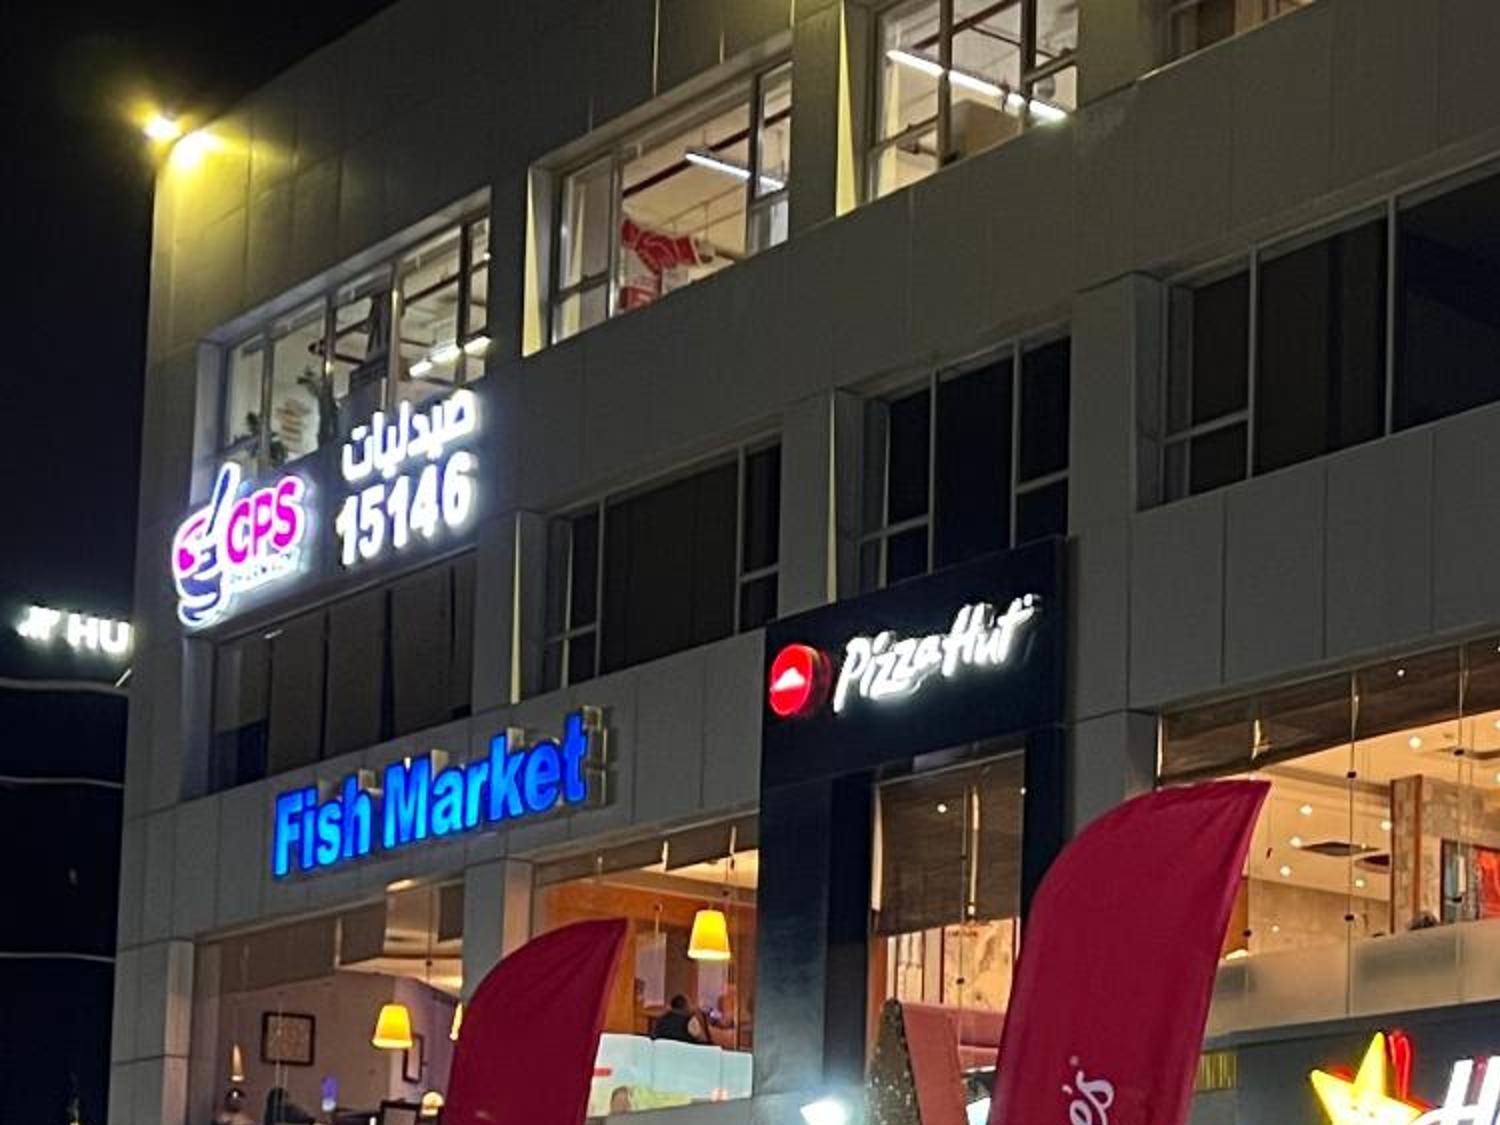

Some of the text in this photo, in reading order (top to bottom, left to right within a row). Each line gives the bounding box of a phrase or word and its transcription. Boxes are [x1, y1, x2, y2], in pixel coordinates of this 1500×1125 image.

[341, 387, 477, 481] صيدليات
[226, 475, 304, 565] CPS
[335, 450, 473, 566] 15146
[834, 594, 1037, 713] Pizza Hut
[273, 709, 590, 879] Fish Market
